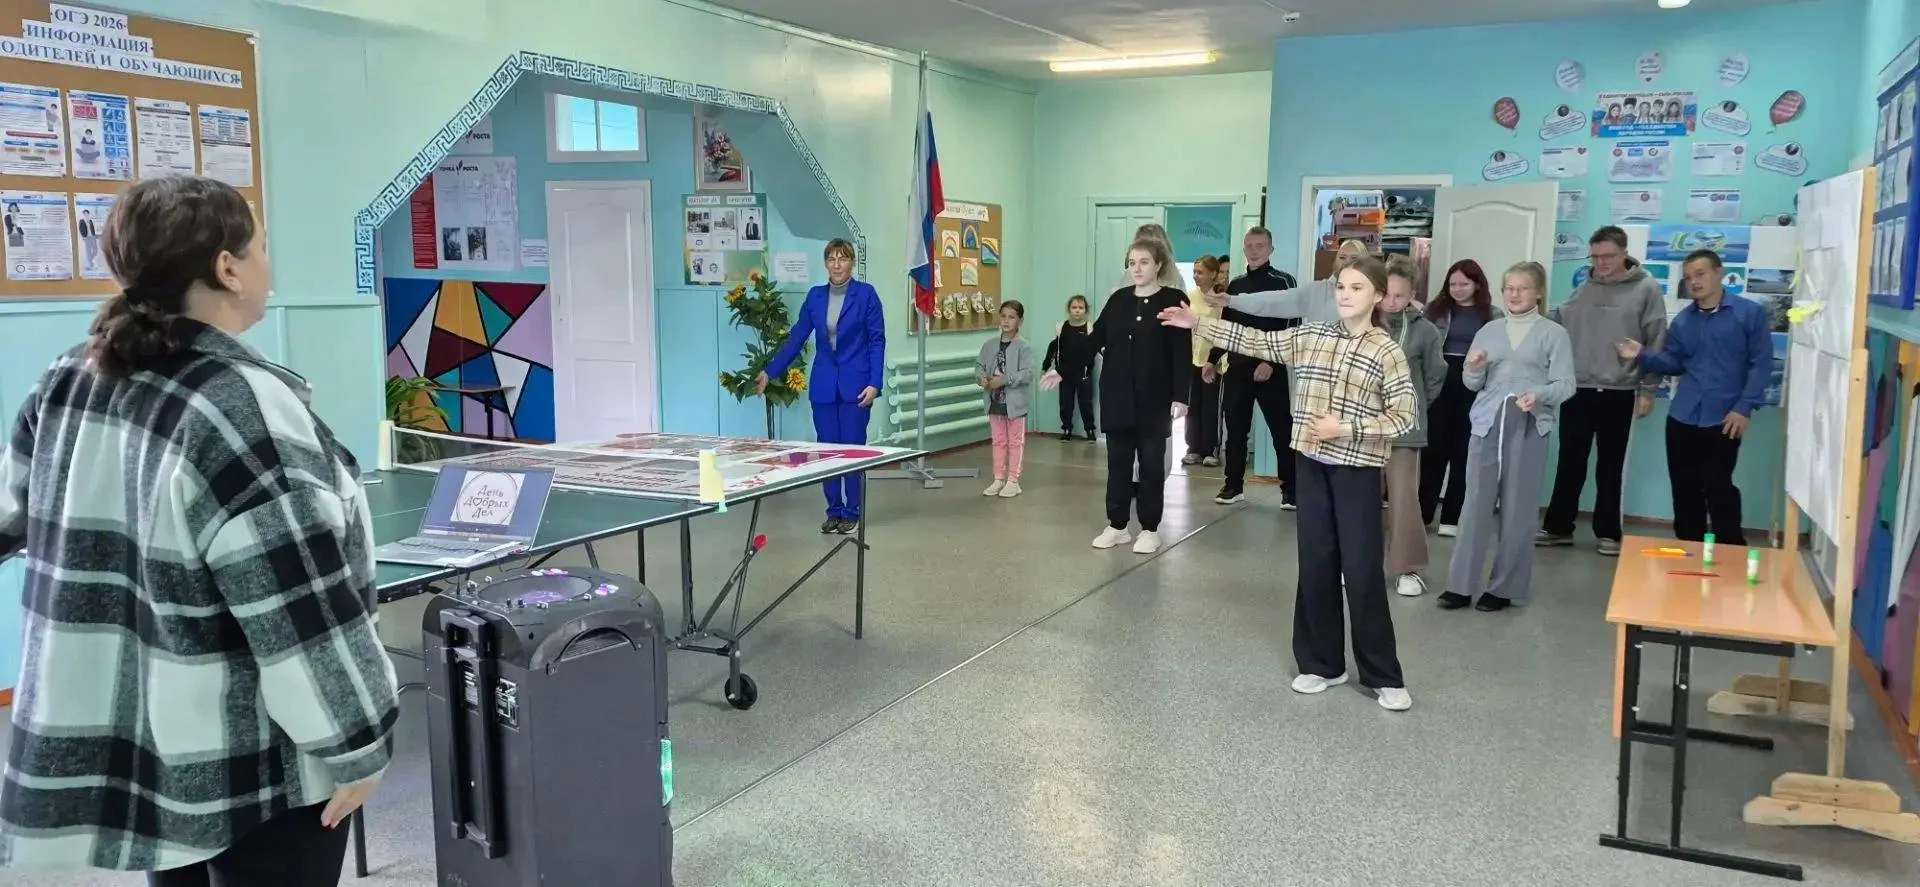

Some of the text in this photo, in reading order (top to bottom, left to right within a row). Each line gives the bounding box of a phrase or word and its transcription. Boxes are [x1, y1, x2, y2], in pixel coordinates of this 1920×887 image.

[54, 8, 124, 30] ОГЭ 2026
[27, 24, 149, 53] ИНФОРМАЦИЯ
[1, 40, 239, 84] ОДИТЕЛЕЙ И ОБУЧАЮЩИХСЯ
[477, 484, 504, 497] День
[472, 507, 494, 519] Дел
